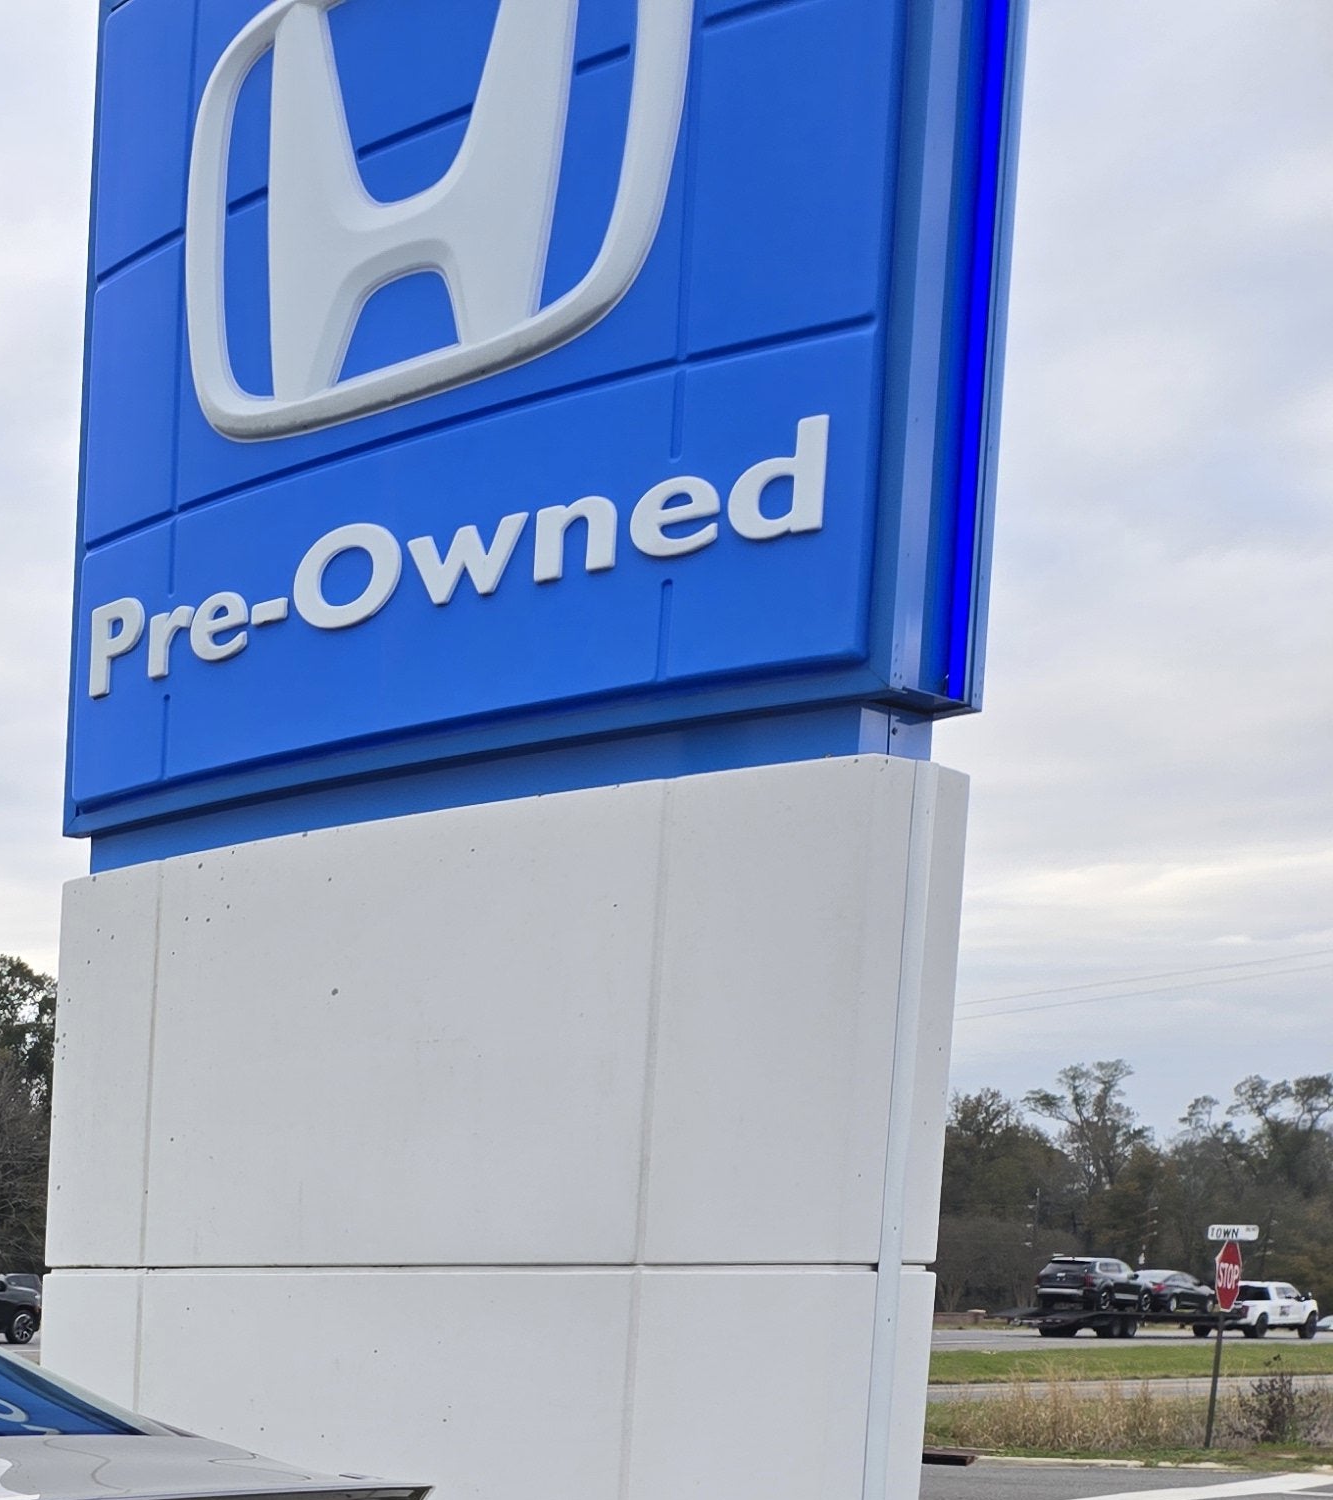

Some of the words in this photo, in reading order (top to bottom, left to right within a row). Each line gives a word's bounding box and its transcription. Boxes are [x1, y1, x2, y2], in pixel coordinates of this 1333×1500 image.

[88, 413, 830, 699] Pre-Owned
[1210, 1227, 1239, 1239] TOWN
[1217, 1262, 1240, 1290] STOP
